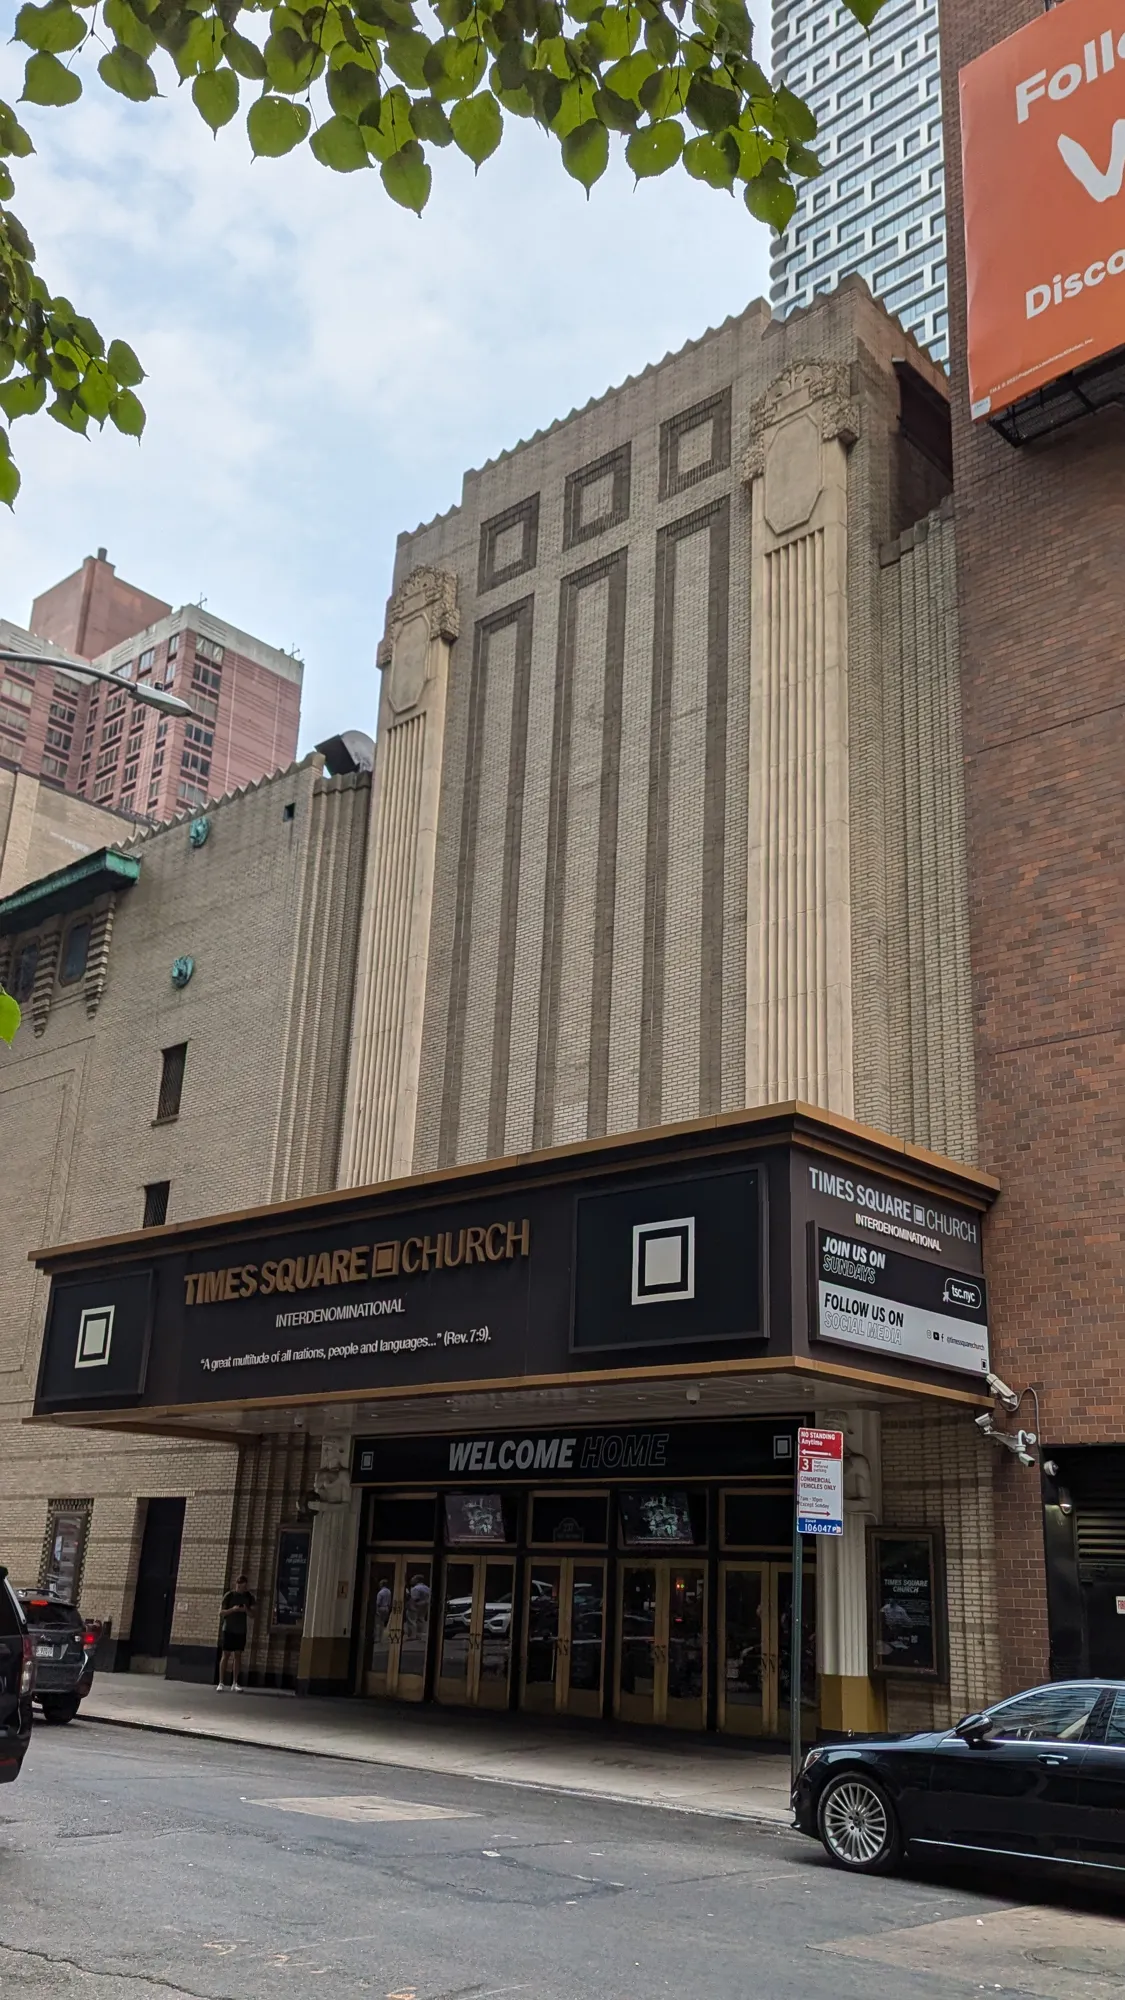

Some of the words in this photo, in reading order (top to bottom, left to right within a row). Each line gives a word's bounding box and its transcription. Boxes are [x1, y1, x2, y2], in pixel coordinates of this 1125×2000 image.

[1016, 29, 1125, 124] Foll
[809, 1166, 854, 1202] TIMES
[857, 1184, 912, 1223] SQUARE
[926, 1209, 977, 1244] CHURCH
[855, 1213, 942, 1252] INTERDENOMINATIONAL
[184, 1265, 258, 1306] TIMES
[260, 1246, 370, 1295] SQUARE
[401, 1219, 530, 1273] CHURCH
[823, 1236, 850, 1258] JOIN
[852, 1245, 867, 1263] US
[869, 1250, 886, 1269] ON
[823, 1254, 876, 1284] SUNDAYS
[951, 1285, 975, 1303] tsc.nyc
[276, 1298, 405, 1328] INTERDENOMINATIONAL
[824, 1292, 869, 1318] FOLLOW
[871, 1305, 885, 1322] US
[888, 1310, 904, 1327] ON
[824, 1311, 864, 1336] SOCIAL
[867, 1322, 902, 1345] MEDIA
[211, 1356, 231, 1372] great
[232, 1352, 269, 1367] multitude
[271, 1350, 281, 1363] of
[281, 1349, 291, 1361] all
[293, 1347, 326, 1360] nations,
[328, 1342, 359, 1360] people
[360, 1340, 378, 1354] and
[444, 1330, 468, 1346] (Rev.
[470, 1326, 492, 1342] 7:9).
[801, 1438, 823, 1446] Anytime
[810, 1432, 836, 1440] STANDING
[449, 1438, 577, 1471] WELCOME
[580, 1433, 669, 1468] HOME
[802, 1458, 809, 1470] 3
[800, 1475, 831, 1484] COMMERCIAL
[800, 1482, 822, 1490] VEHICLES
[805, 1523, 832, 1533] 106047
[884, 1578, 902, 1586] TIMES
[903, 1579, 928, 1587] SQUARE
[893, 1586, 919, 1594] CHURCH
